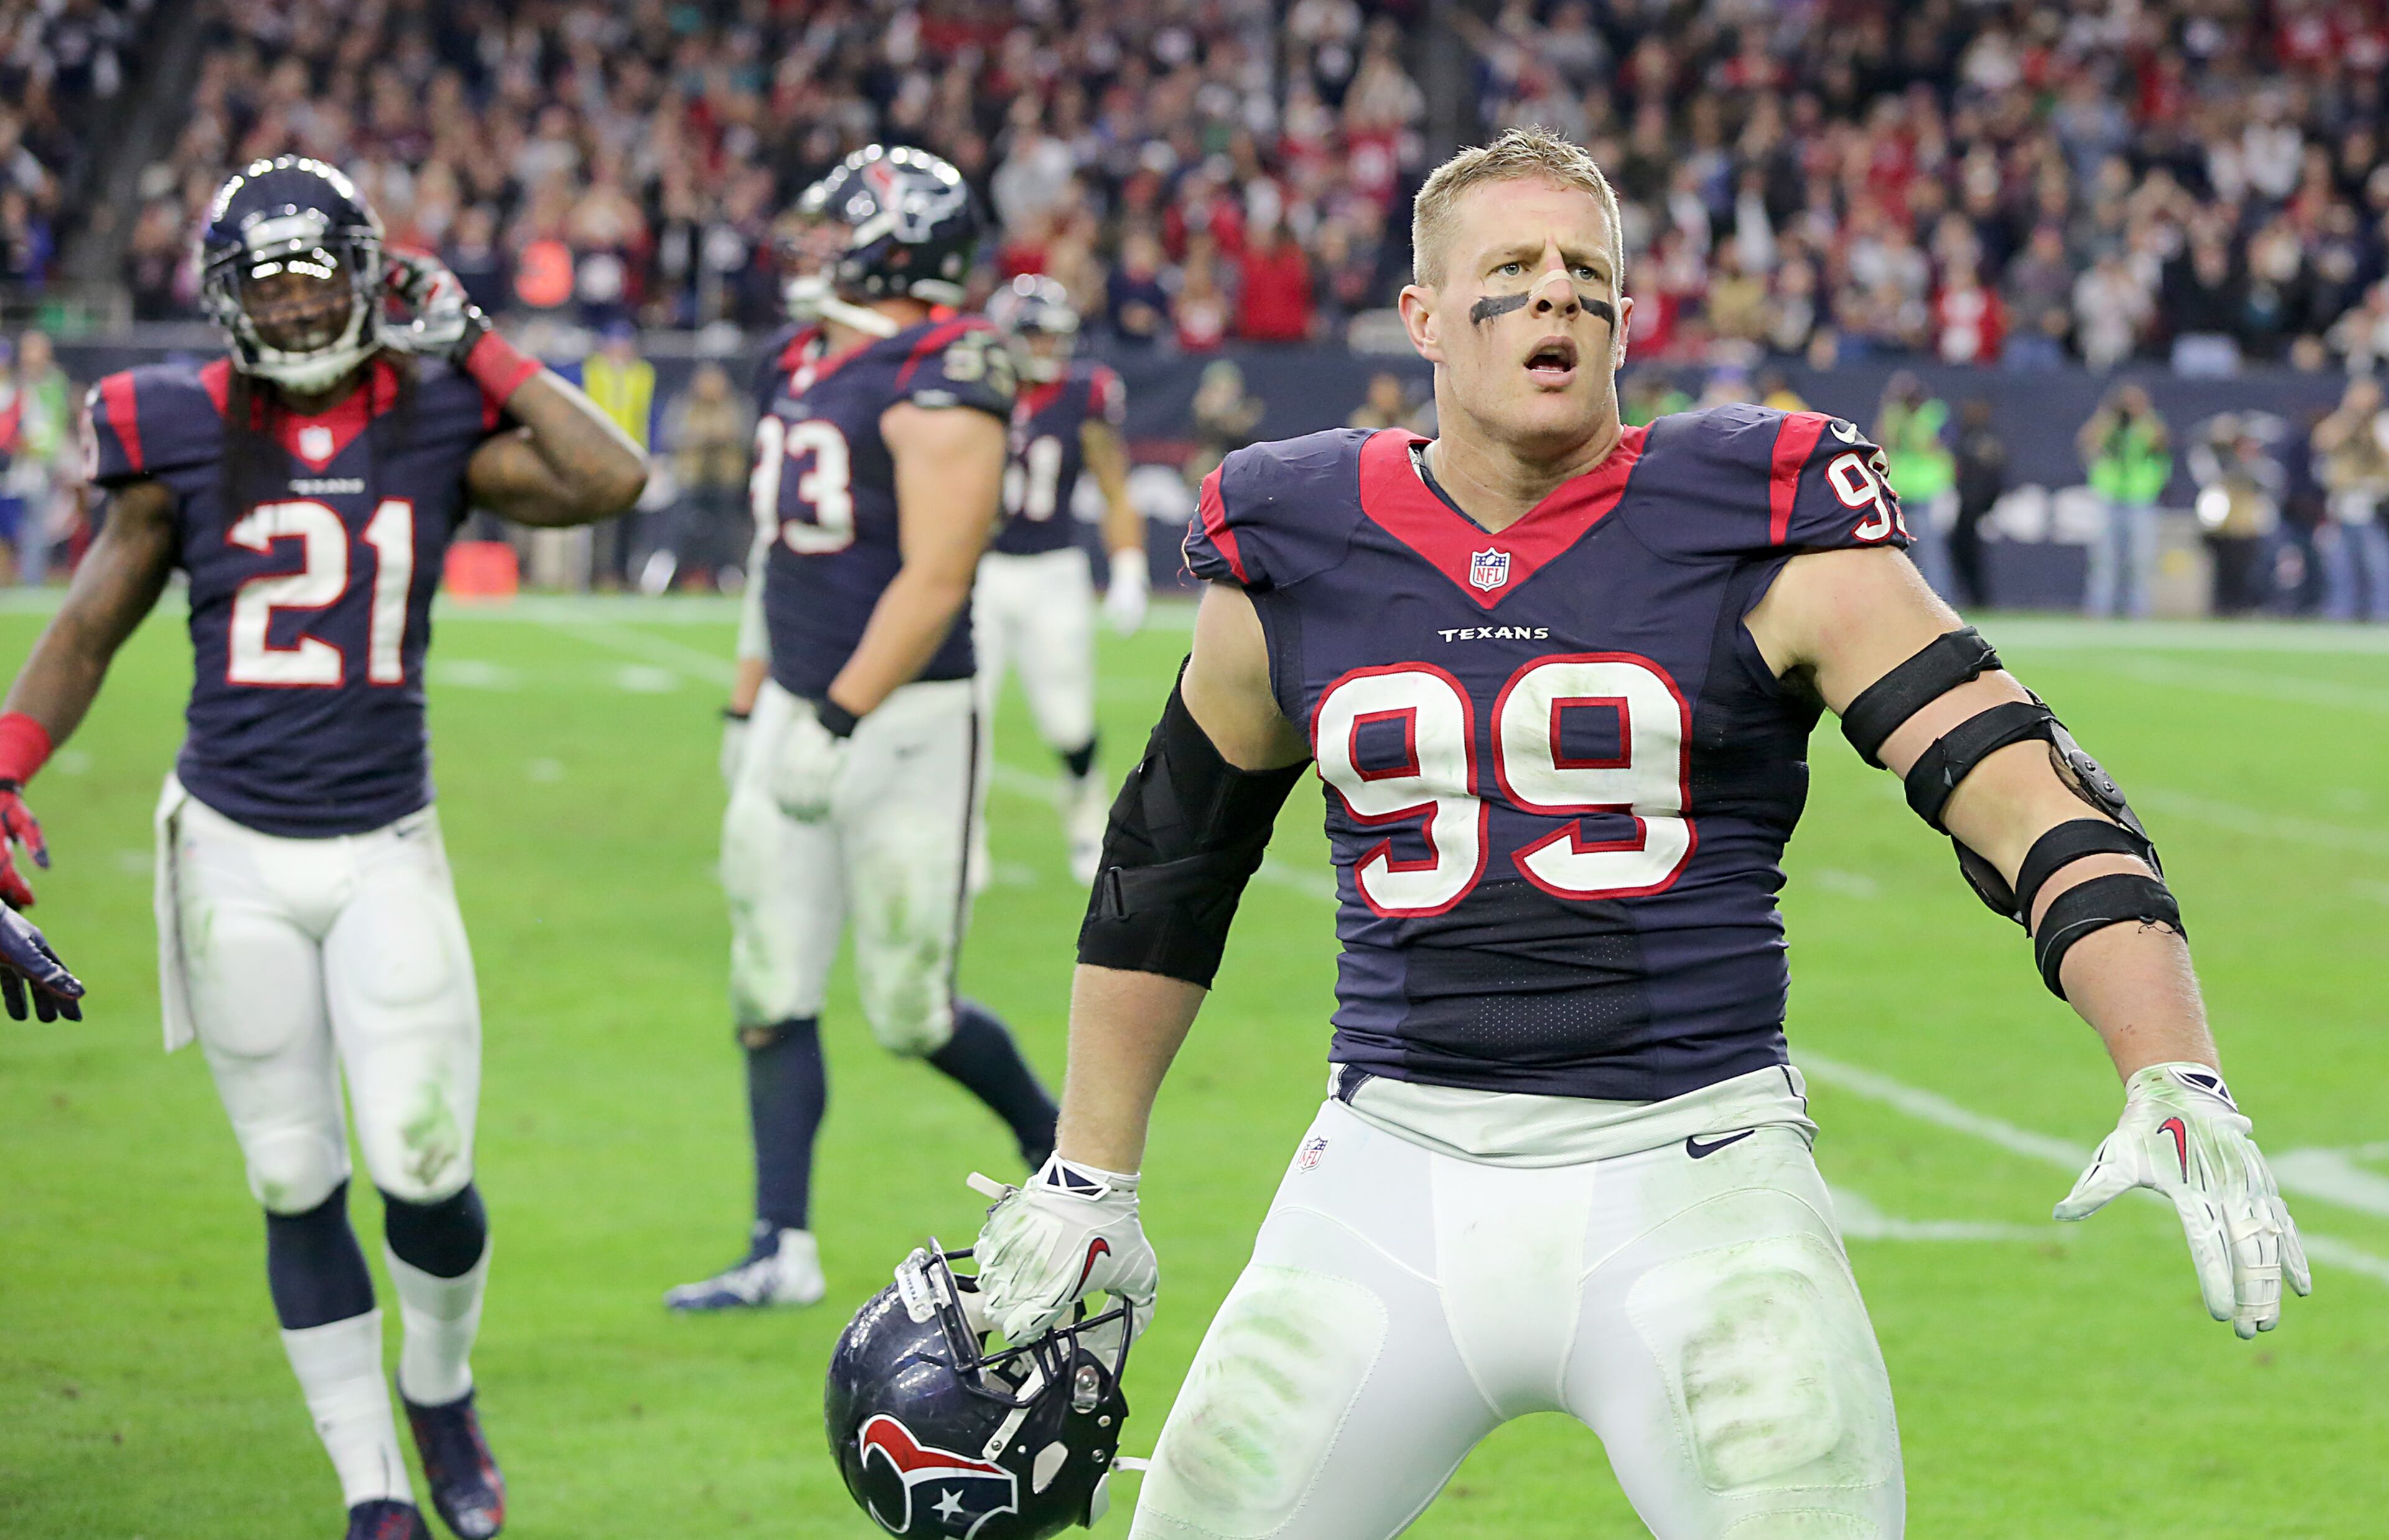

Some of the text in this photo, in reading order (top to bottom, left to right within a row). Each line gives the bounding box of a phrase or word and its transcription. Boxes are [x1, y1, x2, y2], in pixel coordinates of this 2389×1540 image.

[1476, 567, 1501, 583] NFL
[225, 497, 415, 687] 21
[1437, 626, 1549, 642] TEXANS
[1310, 651, 1698, 918] 99
[1299, 1151, 1318, 1166] NFL
